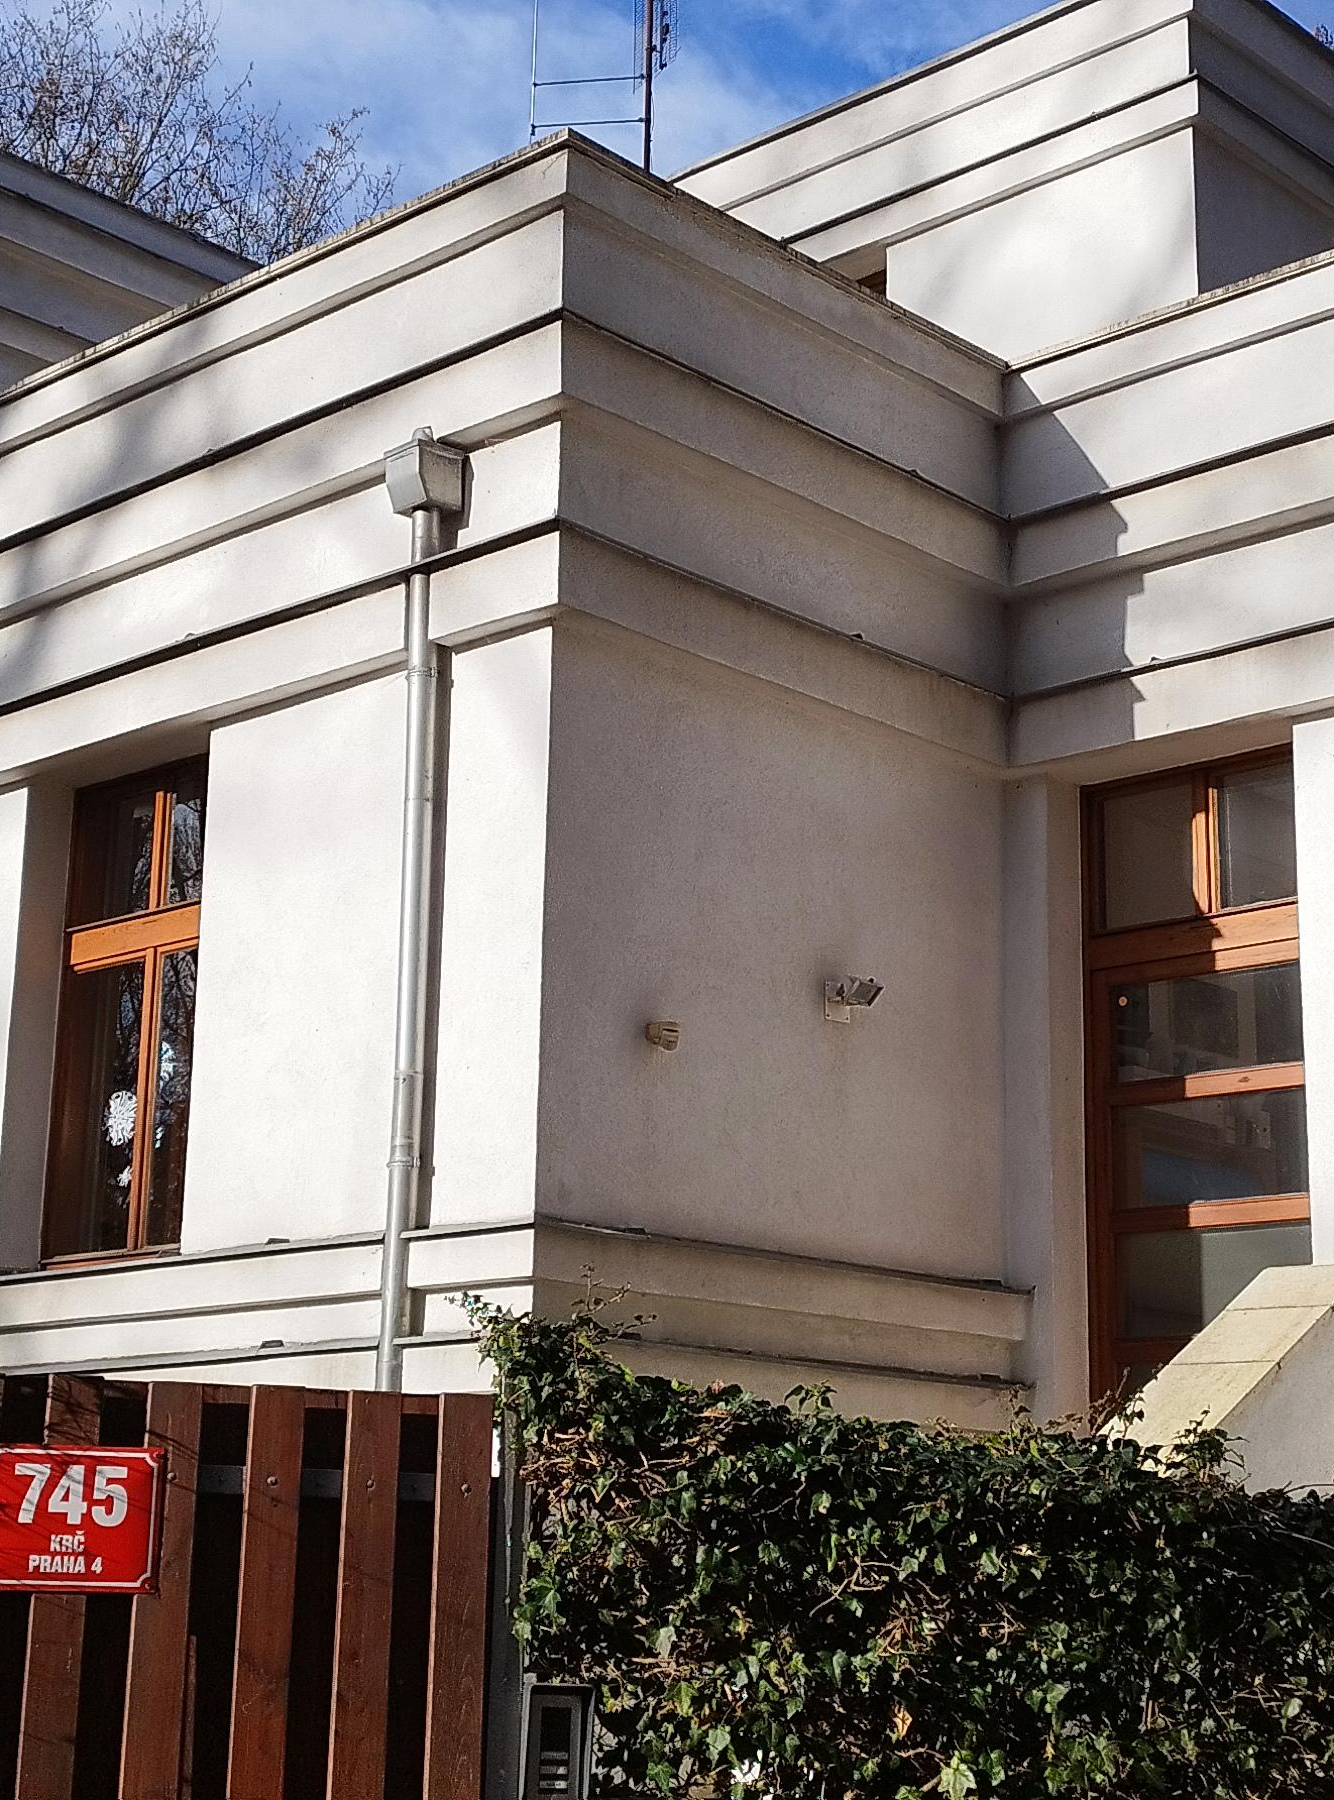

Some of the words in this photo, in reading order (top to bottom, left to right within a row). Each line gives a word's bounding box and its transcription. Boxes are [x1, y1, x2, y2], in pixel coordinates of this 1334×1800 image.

[14, 1463, 128, 1527] 745
[50, 1530, 85, 1552] KRČ
[28, 1554, 86, 1573] PRAHA
[91, 1556, 103, 1574] 4
